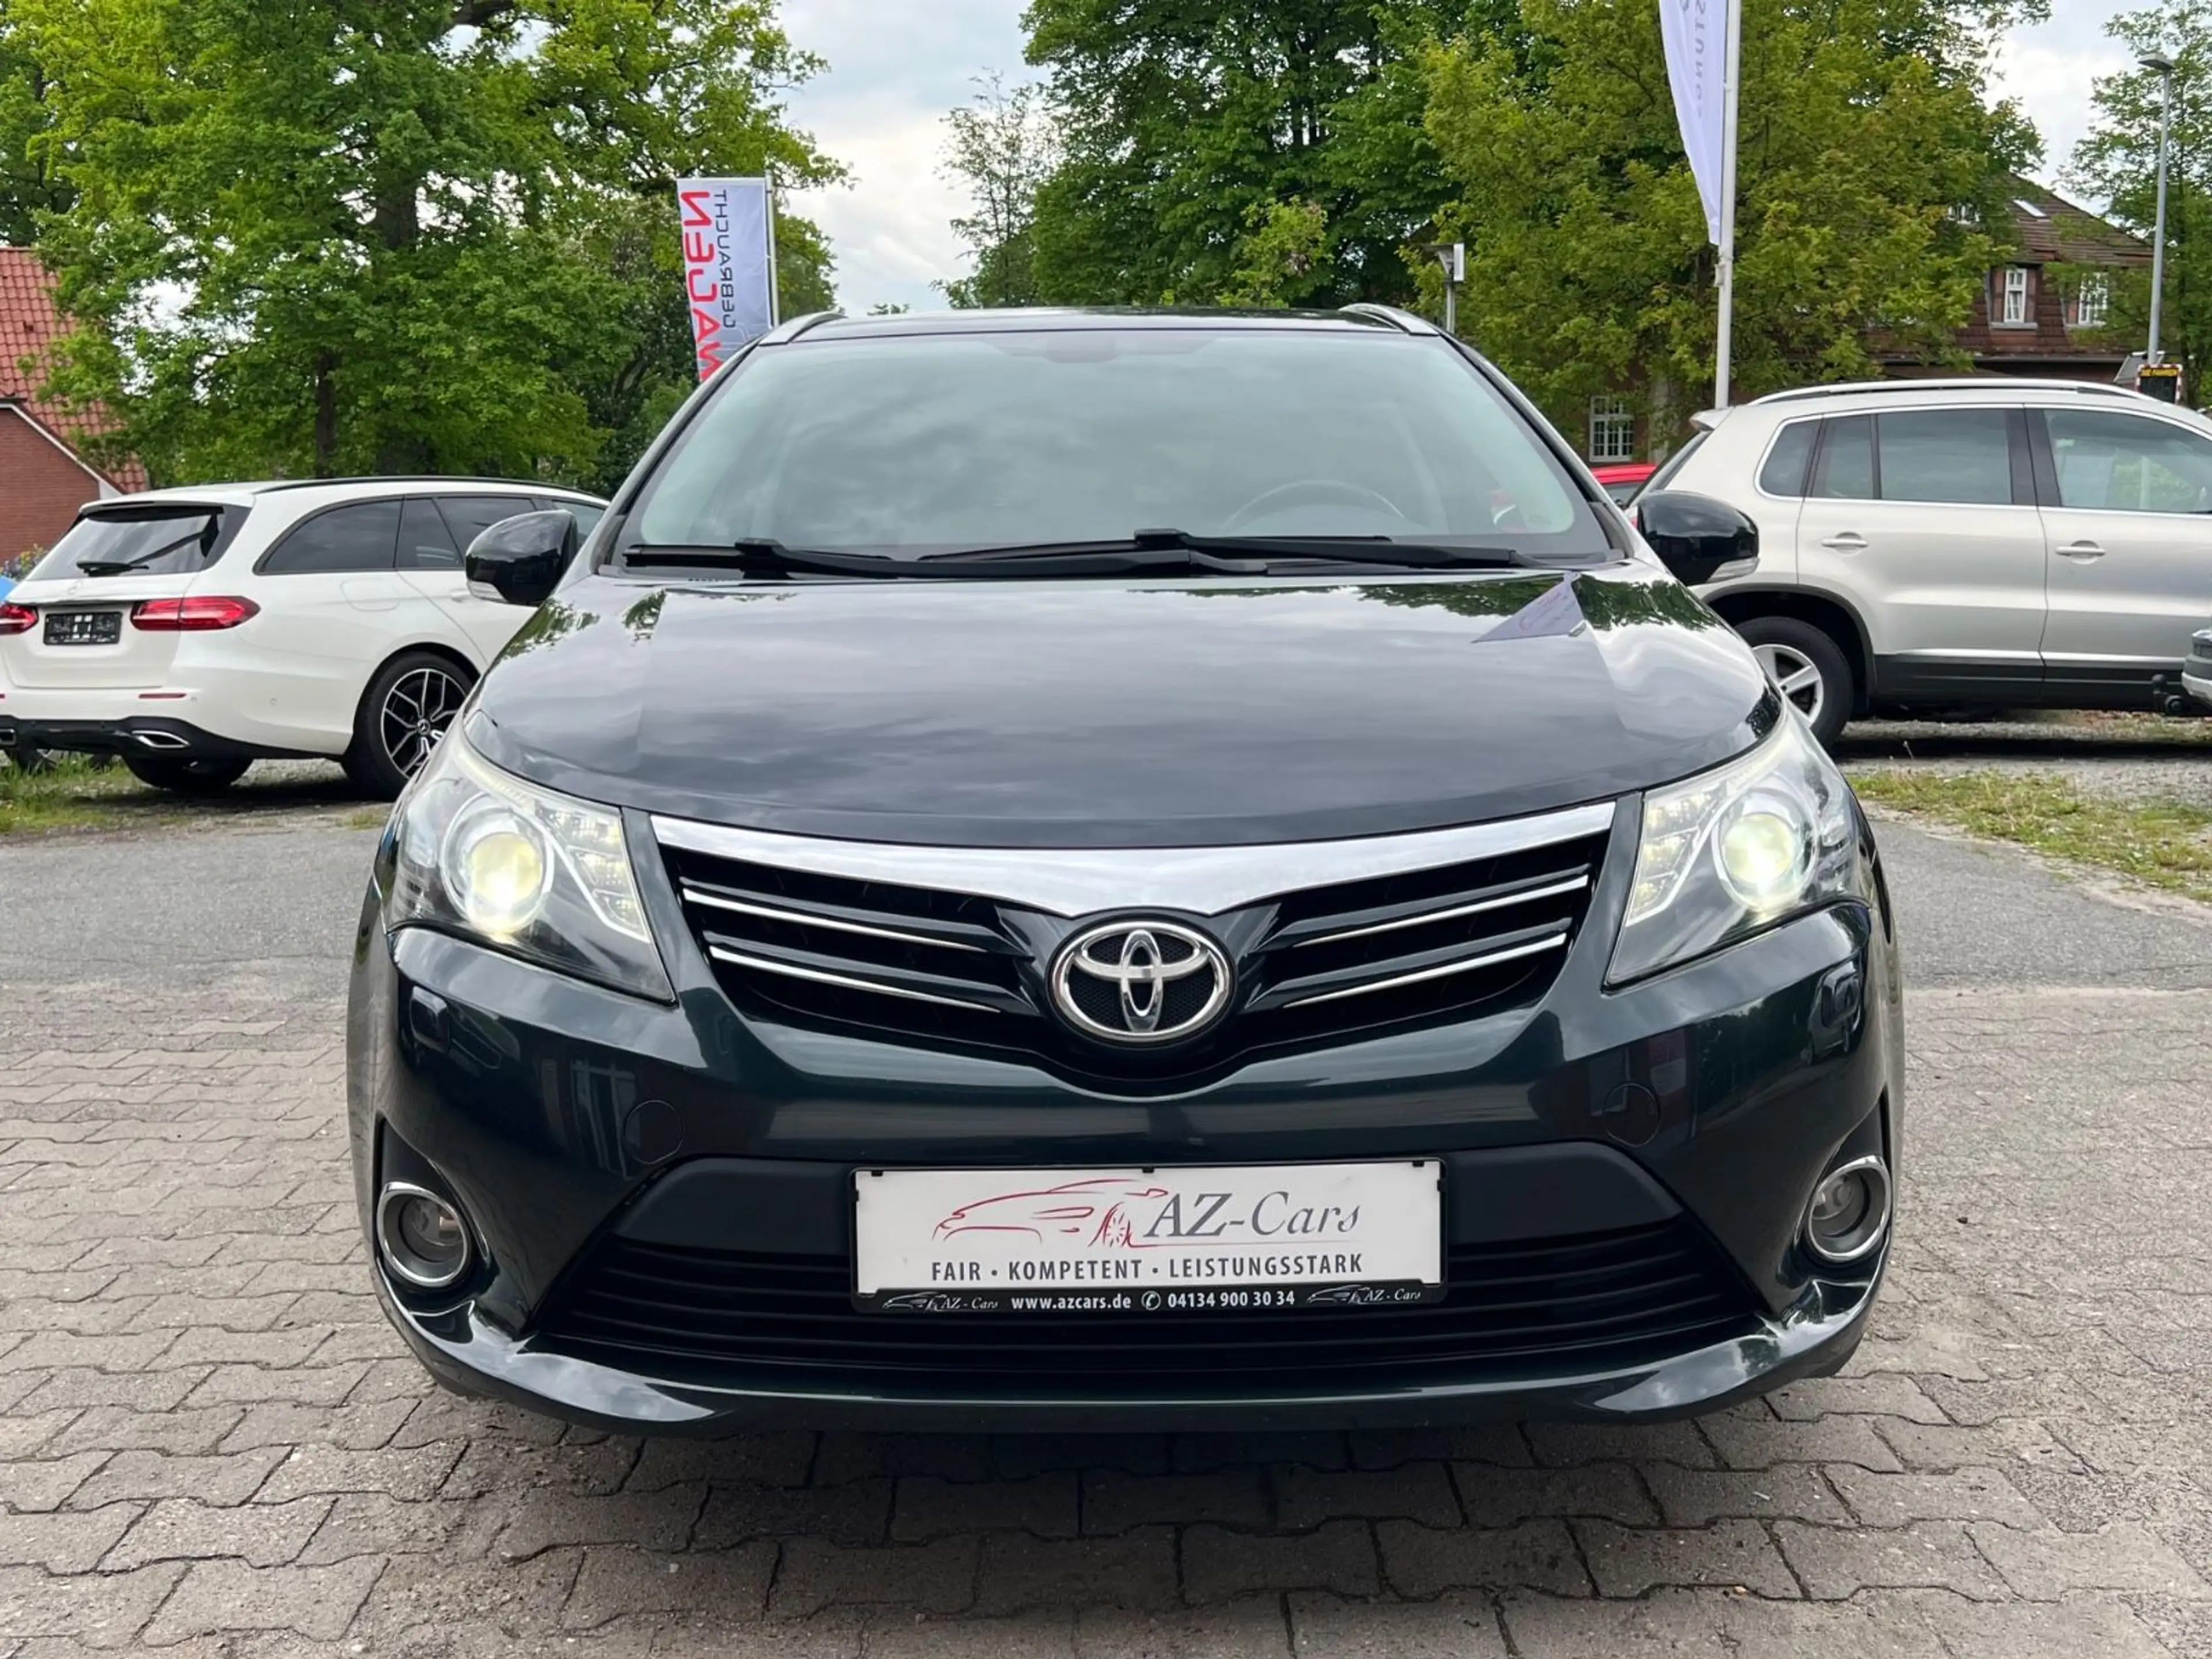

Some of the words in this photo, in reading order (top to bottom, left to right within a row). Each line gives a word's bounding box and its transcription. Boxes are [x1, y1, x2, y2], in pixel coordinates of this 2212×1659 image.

[1142, 1191, 1361, 1238] AZ-Cars
[931, 1261, 982, 1281] FAIR
[1009, 1259, 1142, 1281] KOMPETENT
[1169, 1253, 1362, 1278] LEISTUNGSSTARK
[1011, 1293, 1132, 1309] www.azcars.de
[1168, 1292, 1215, 1308] 04134
[1219, 1291, 1248, 1306] 900
[1253, 1290, 1272, 1306] 30
[1276, 1290, 1296, 1305] 34
